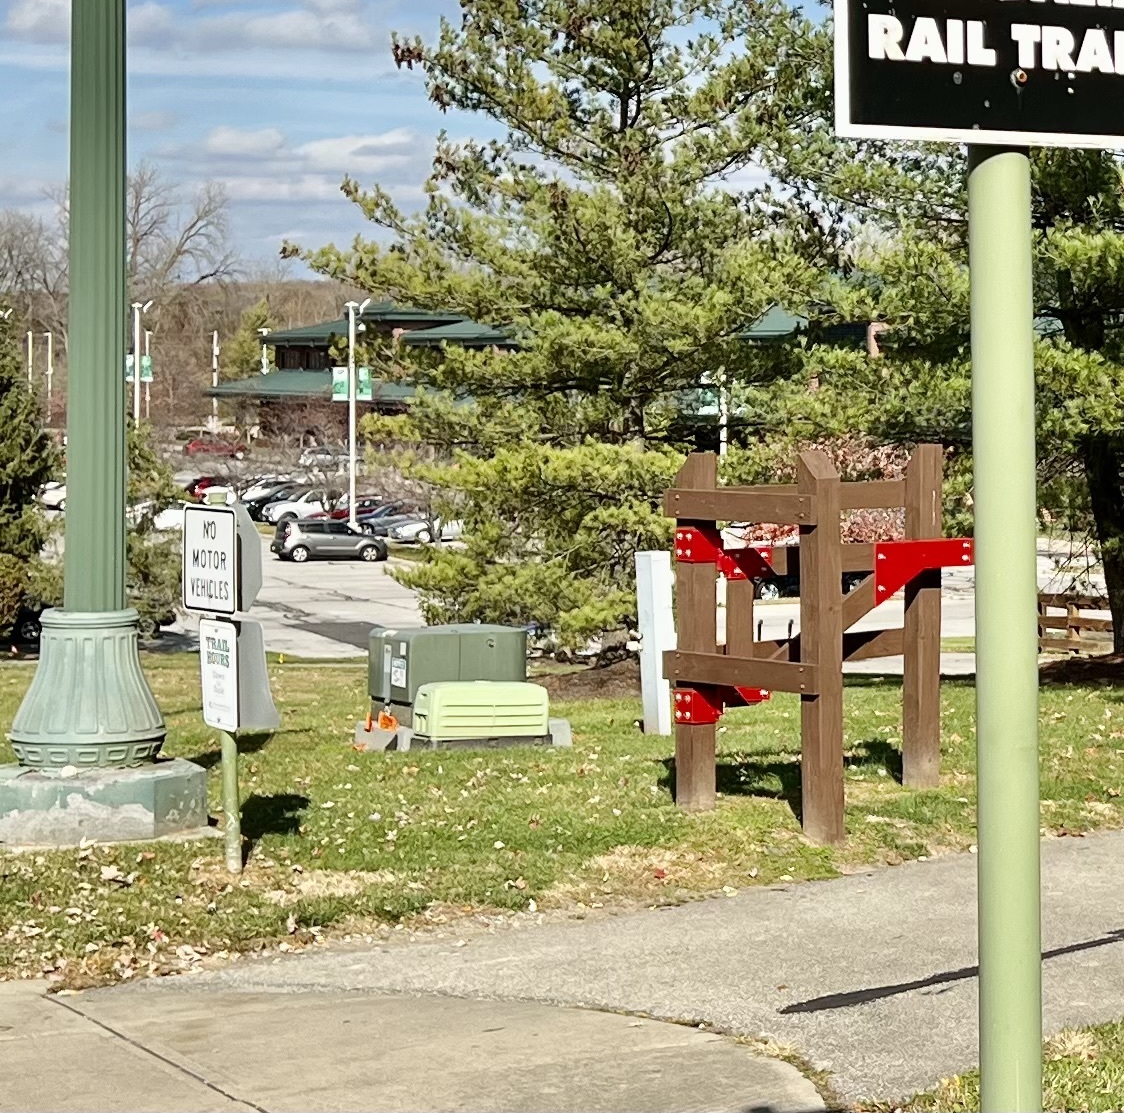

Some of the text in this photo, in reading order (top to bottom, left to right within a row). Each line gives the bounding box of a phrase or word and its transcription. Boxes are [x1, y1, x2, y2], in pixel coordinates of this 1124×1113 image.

[868, 13, 997, 66] RAIL
[203, 520, 217, 540] NO
[192, 549, 227, 570] MOTOR
[190, 577, 229, 600] VEHICLES
[205, 636, 230, 653] TRAIL
